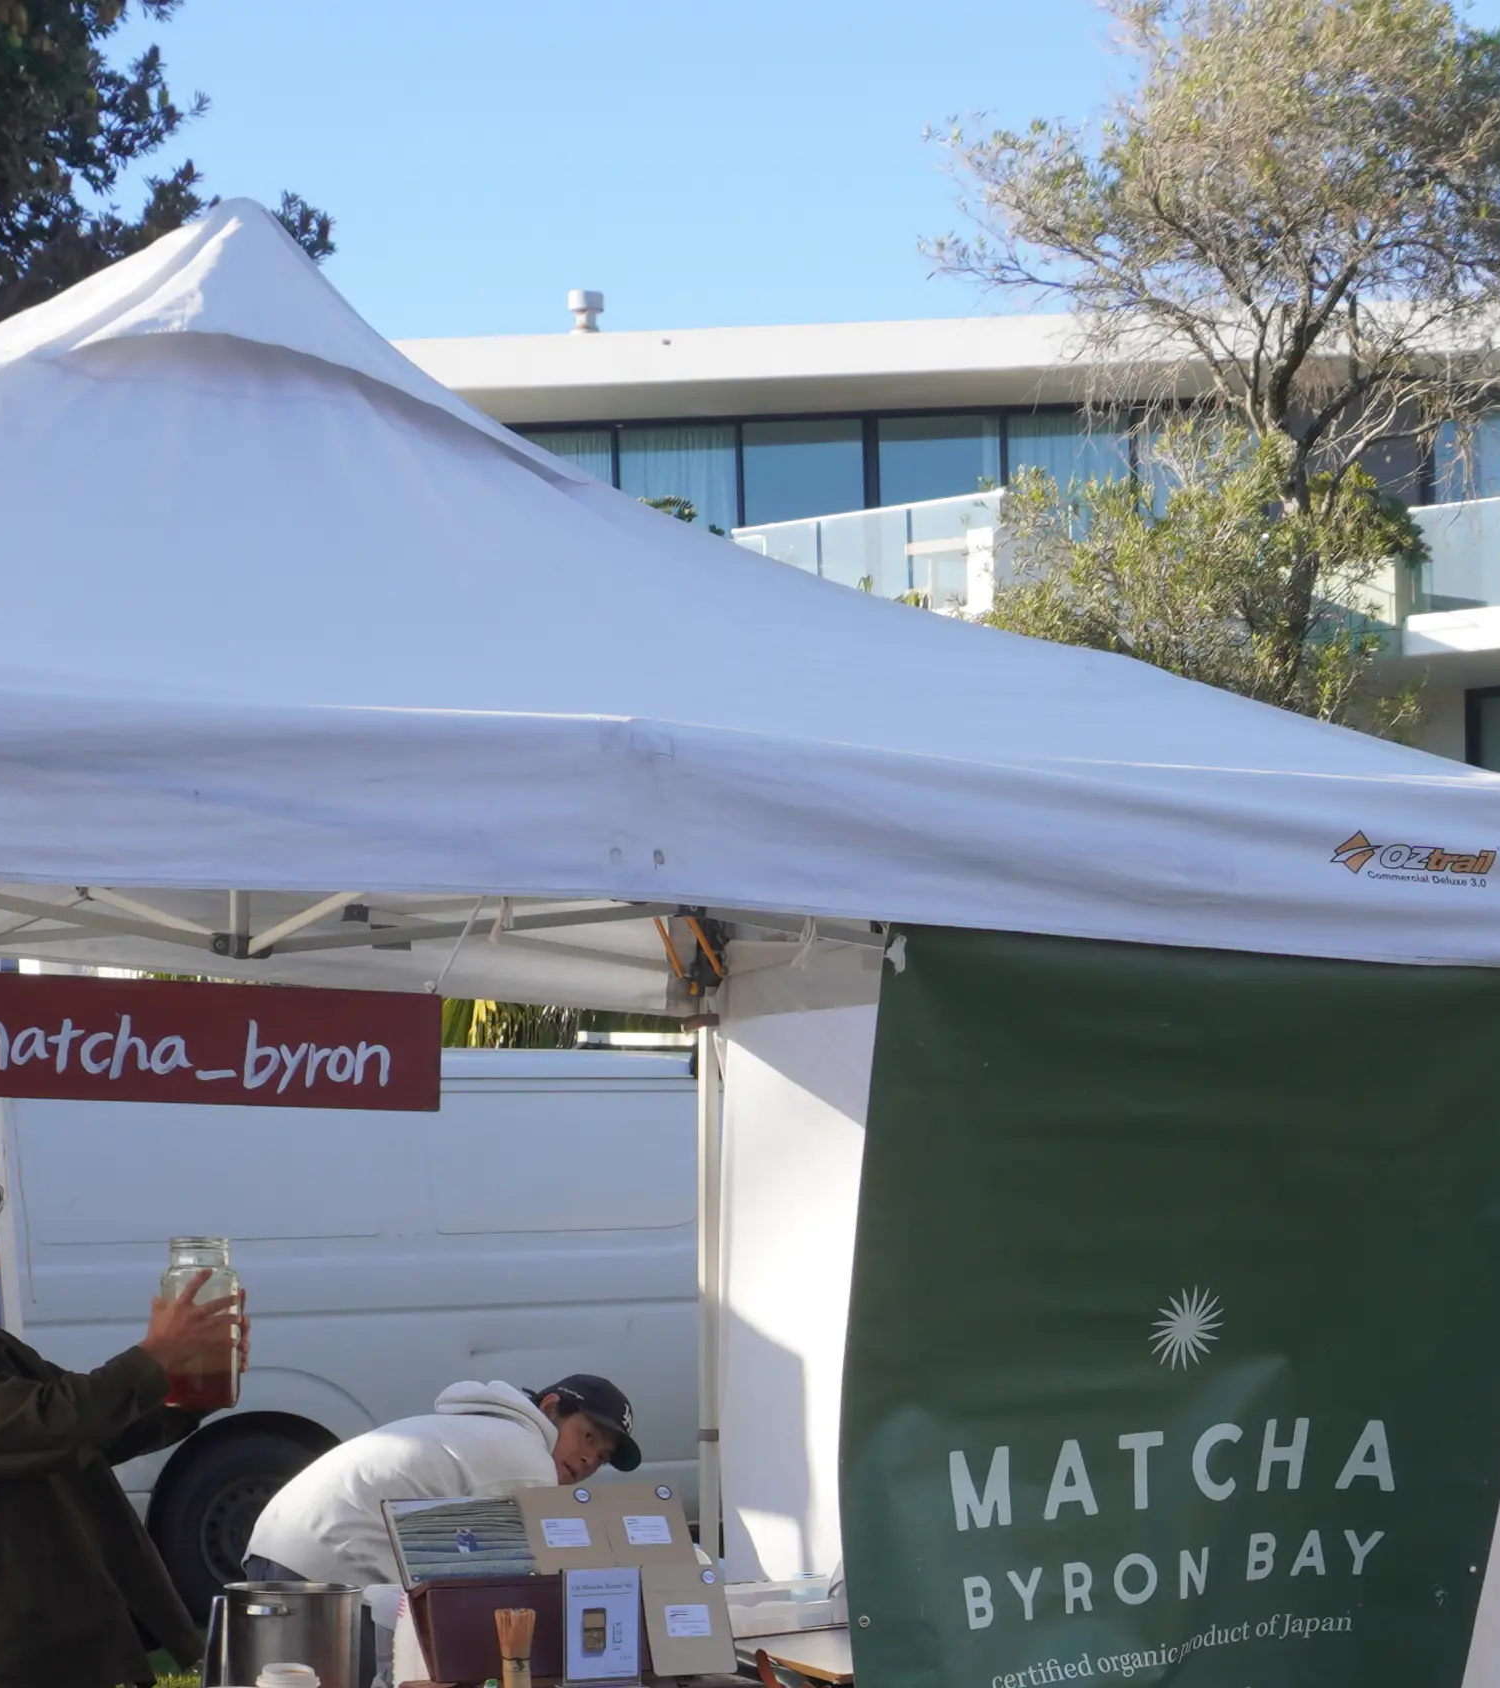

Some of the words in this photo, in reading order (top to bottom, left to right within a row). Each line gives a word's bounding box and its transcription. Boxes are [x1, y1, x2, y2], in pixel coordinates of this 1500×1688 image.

[1367, 870, 1430, 884] Commercial
[1432, 875, 1467, 887] Deluxe
[1470, 877, 1487, 888] 3.0
[1379, 844, 1497, 875] OZtrail
[949, 1417, 1396, 1531] MATCHA
[963, 1547, 1209, 1631] BYRON
[1246, 1529, 1385, 1581] BAY
[1096, 1642, 1179, 1678] organic
[1179, 1617, 1251, 1664] product
[1255, 1614, 1283, 1637] of
[1279, 1611, 1352, 1639] Japan
